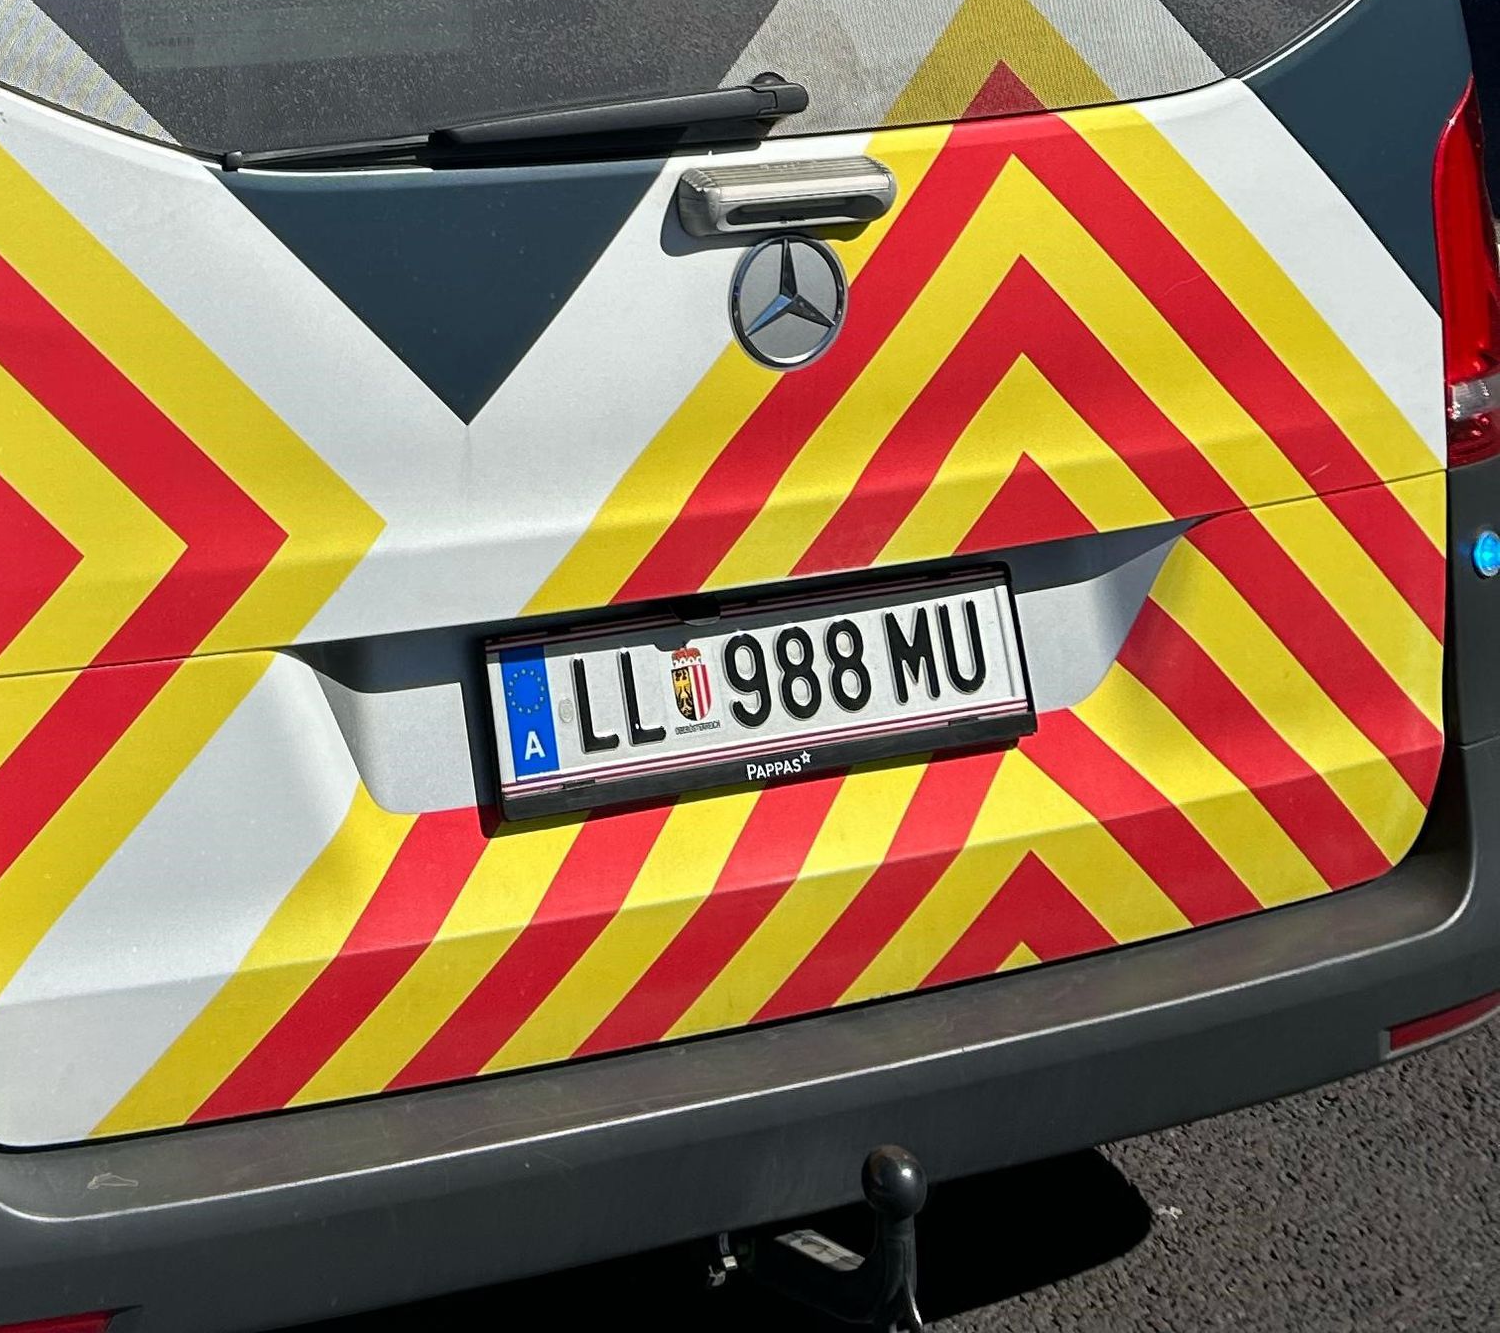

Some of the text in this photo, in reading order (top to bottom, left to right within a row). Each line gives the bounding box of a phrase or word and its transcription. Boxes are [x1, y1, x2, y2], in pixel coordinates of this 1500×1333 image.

[573, 599, 986, 753] LL 988 MU
[524, 731, 546, 760] A
[746, 758, 802, 780] PAPPAS
